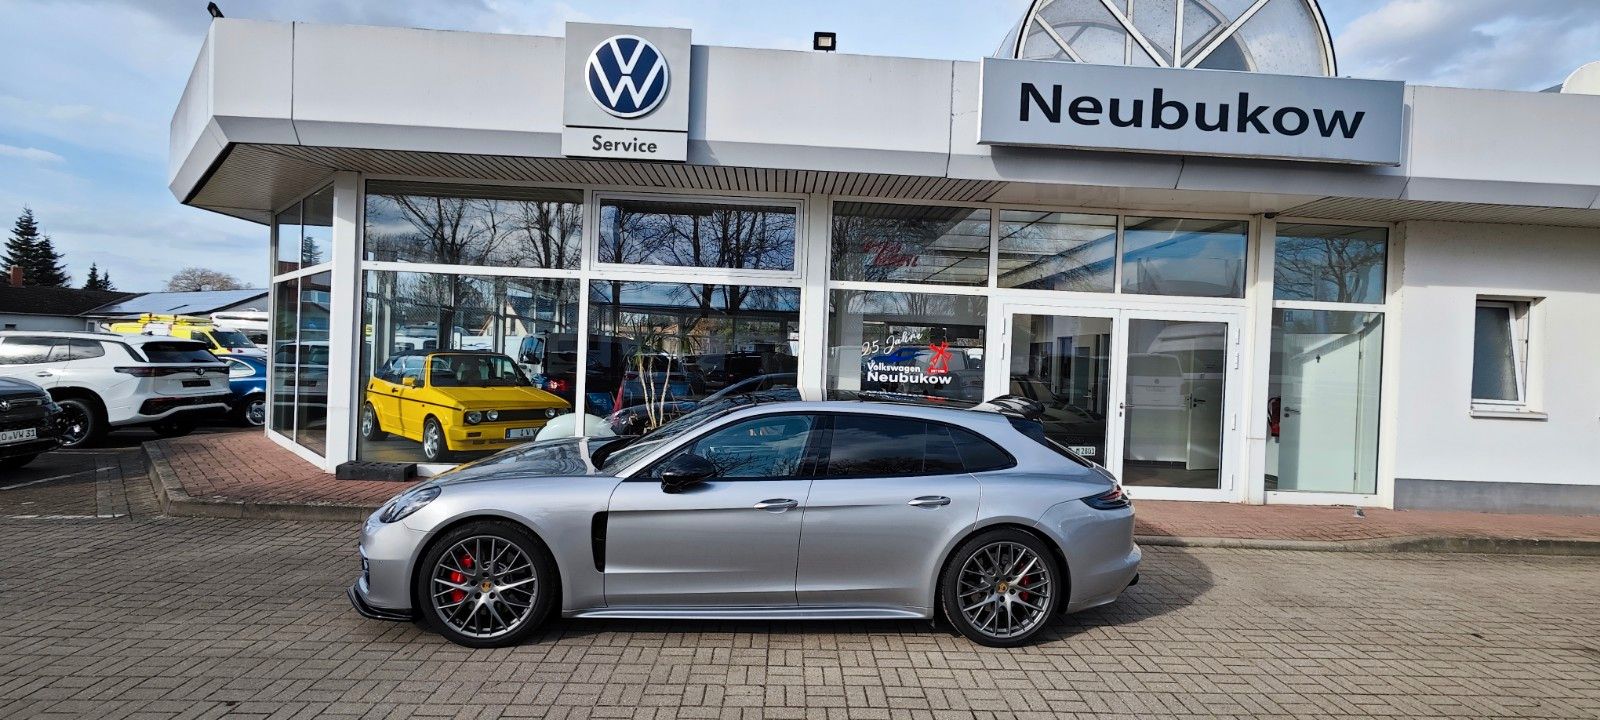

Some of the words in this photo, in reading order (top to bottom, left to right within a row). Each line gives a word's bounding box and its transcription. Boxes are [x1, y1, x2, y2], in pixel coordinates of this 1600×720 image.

[588, 37, 666, 114] VW
[1019, 82, 1366, 139] Neubukow
[592, 135, 657, 153] Service
[861, 340, 880, 357] 25
[883, 331, 923, 355] Jahre
[867, 362, 921, 374] Volkswagen
[867, 372, 952, 385] Neubukow
[26, 429, 35, 438] 31
